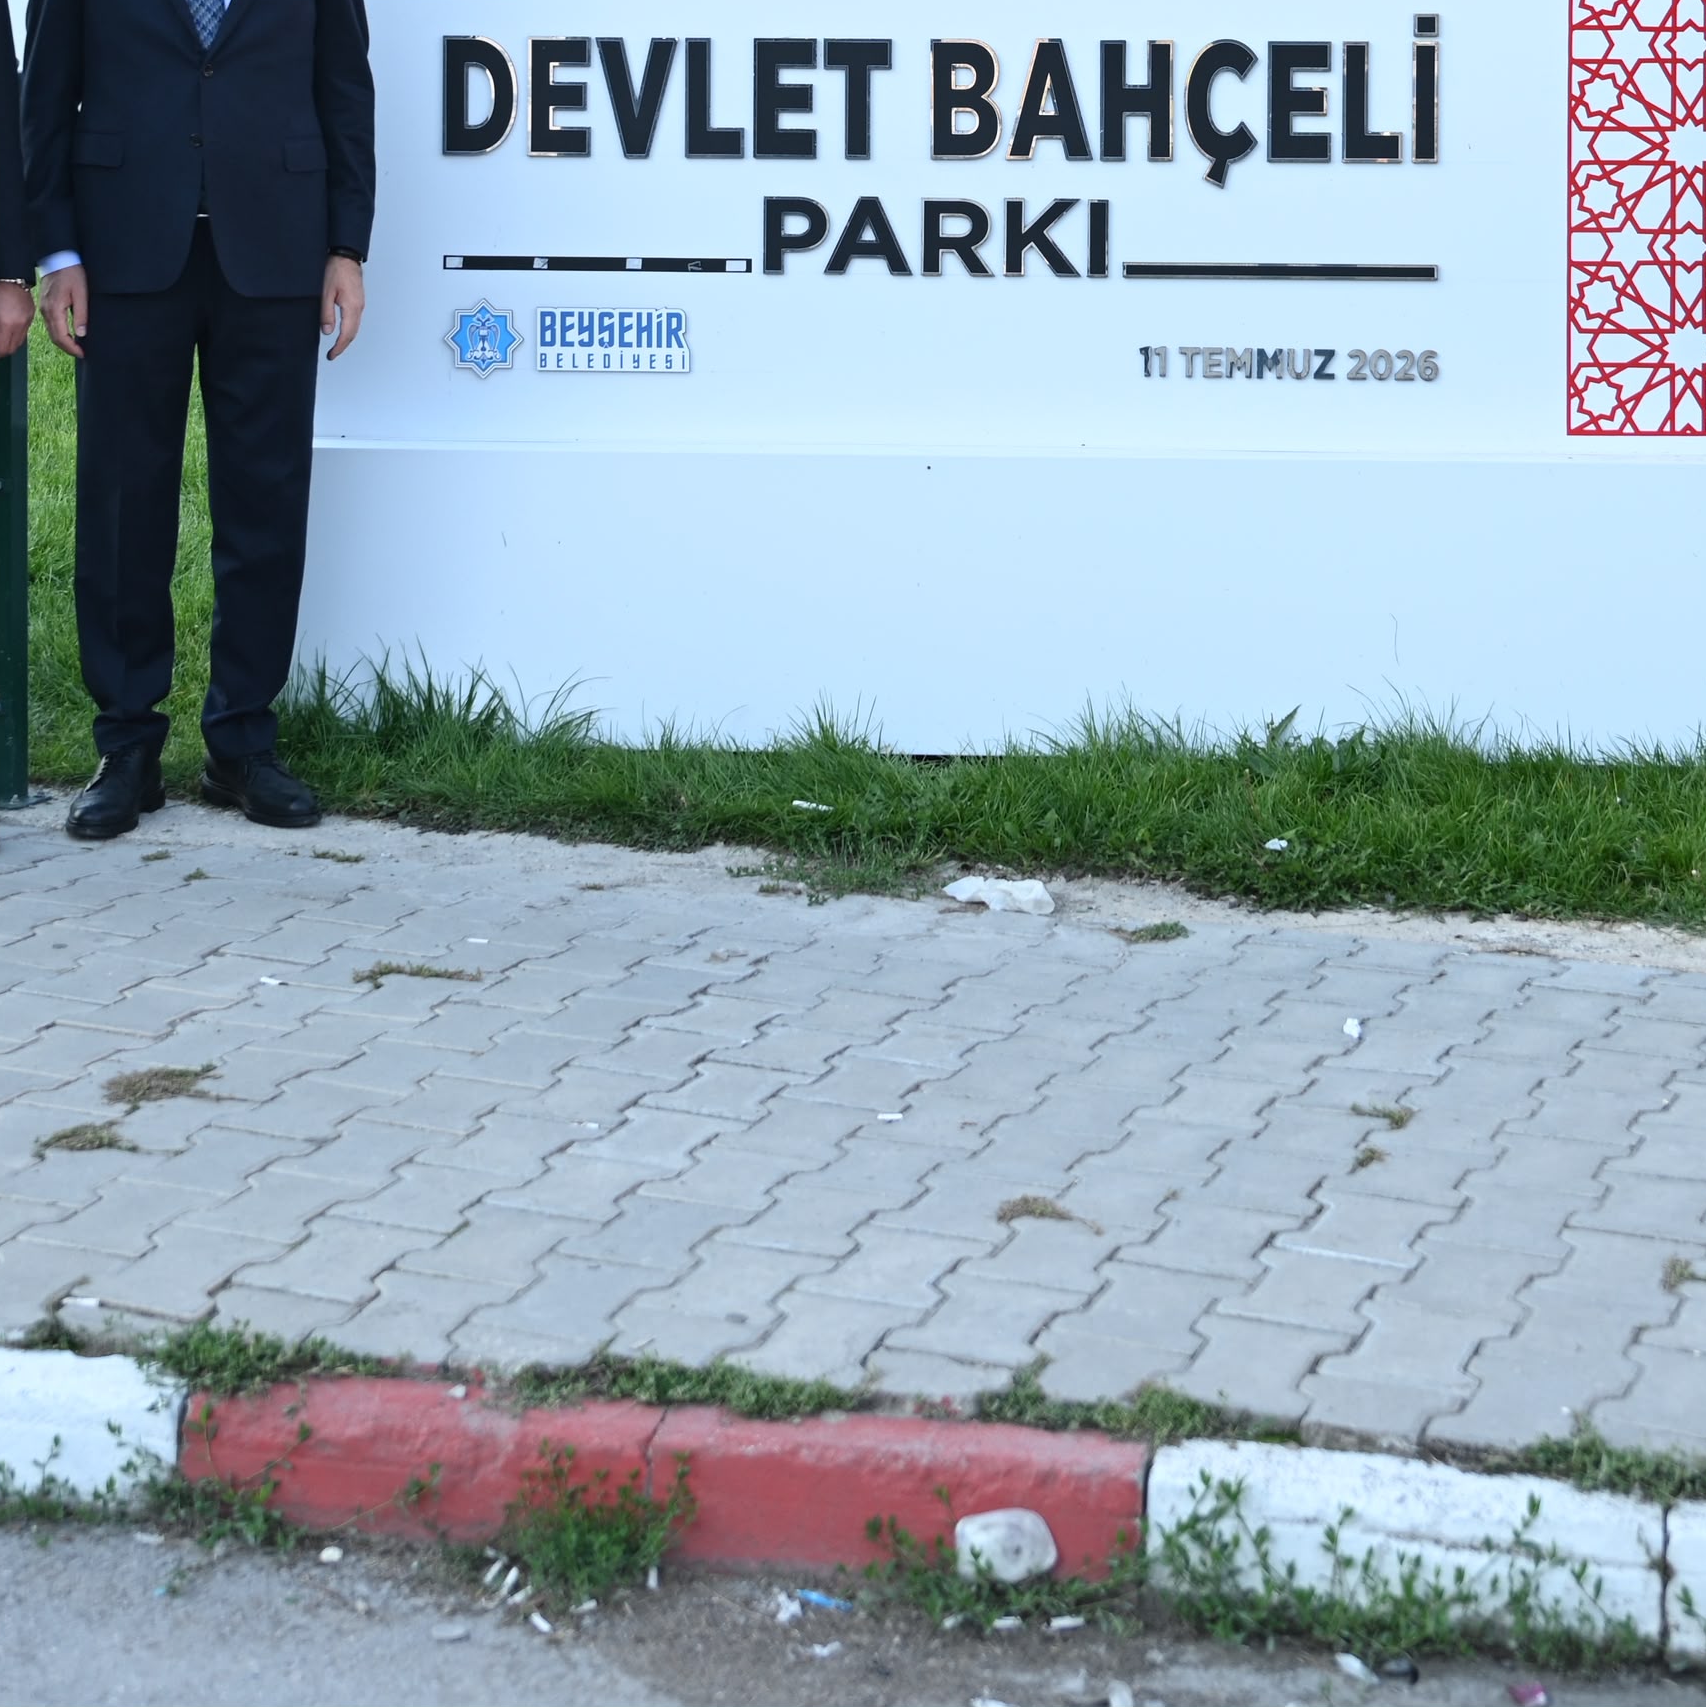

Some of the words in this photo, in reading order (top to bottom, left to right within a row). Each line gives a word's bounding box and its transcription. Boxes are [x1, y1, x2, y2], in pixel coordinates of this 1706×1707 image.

[442, 35, 893, 159] DEVLET
[930, 13, 1439, 189] BAHÇELİ
[763, 195, 1109, 277] PARKI
[539, 350, 686, 370] BELEDİYESİ
[1139, 346, 1167, 378] 11
[1178, 346, 1336, 380] TEMMUZ
[1346, 349, 1440, 381] 2026
